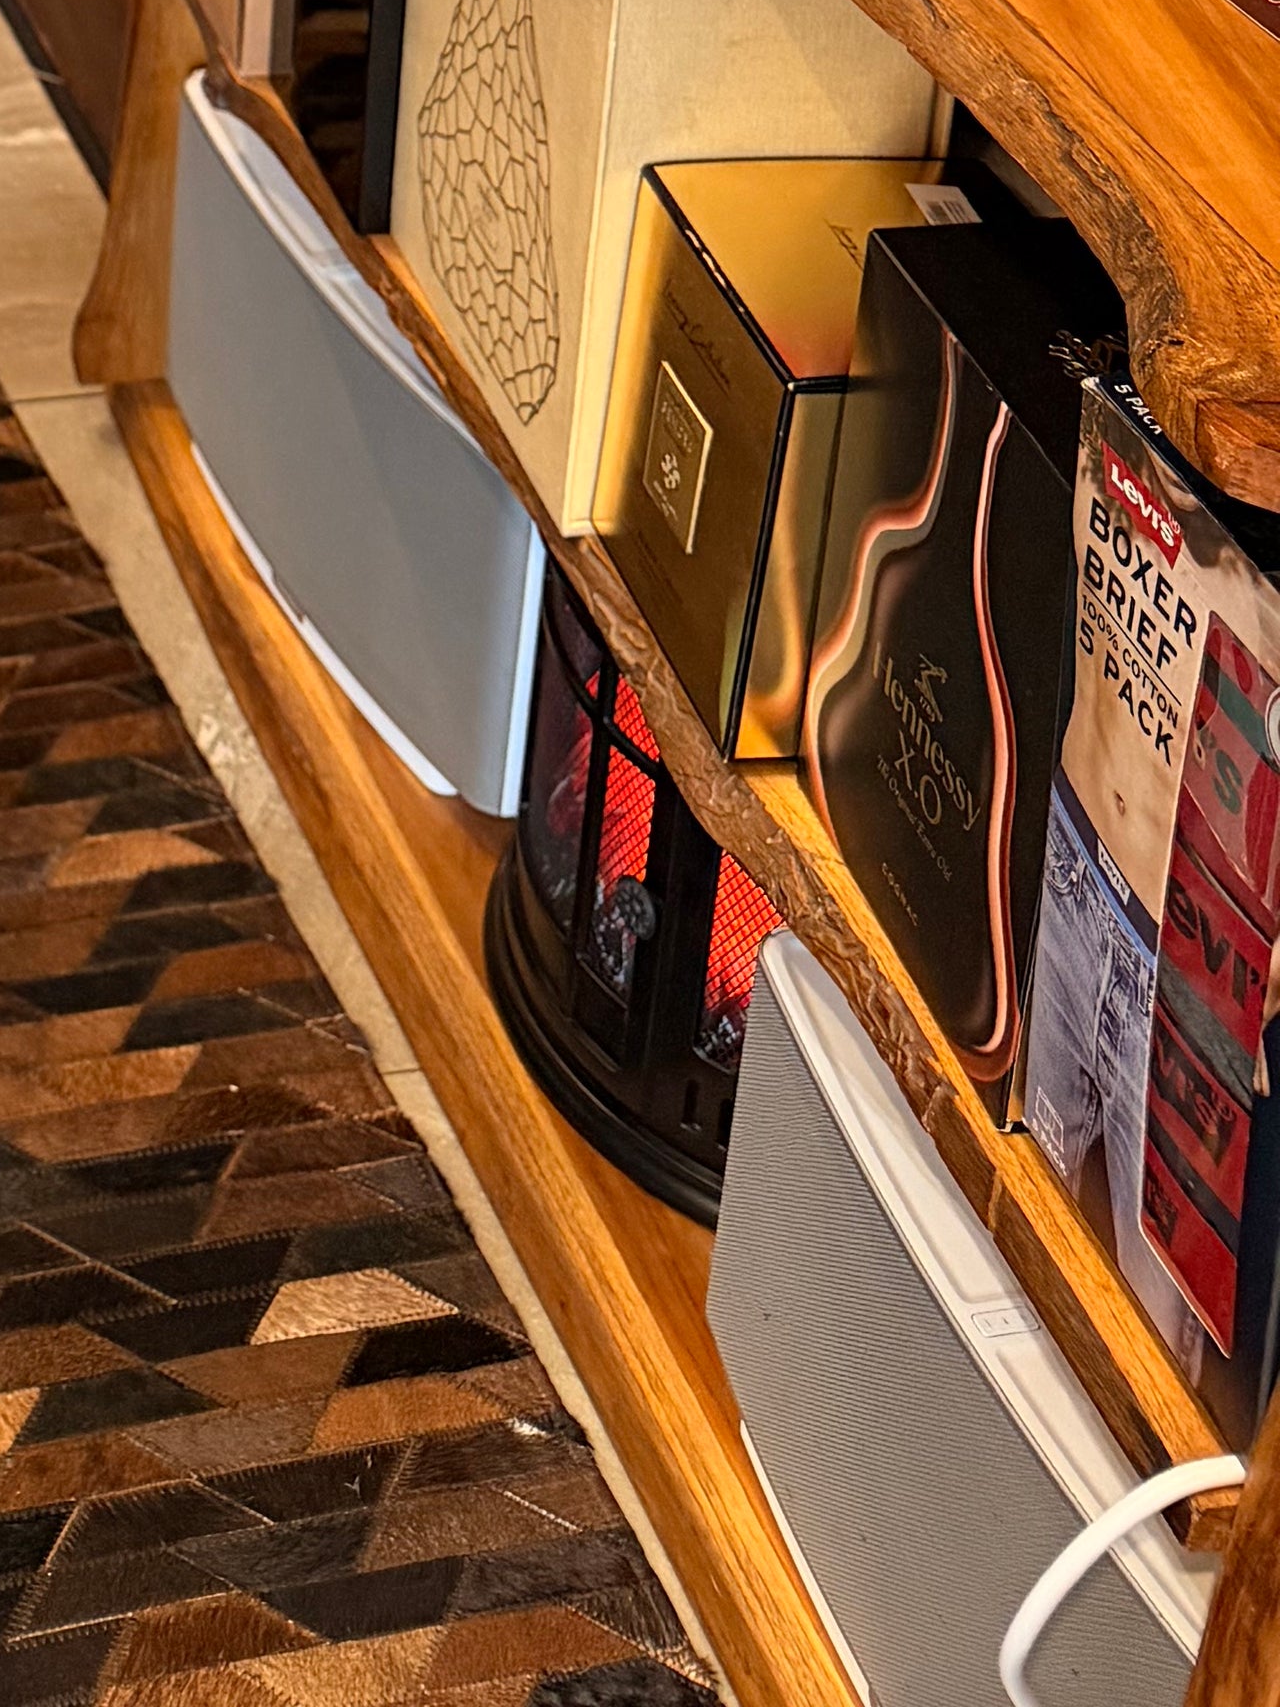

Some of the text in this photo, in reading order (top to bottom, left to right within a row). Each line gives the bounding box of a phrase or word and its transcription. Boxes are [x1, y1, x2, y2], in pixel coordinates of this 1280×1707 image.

[1114, 384, 1132, 394] 5
[1083, 544, 1178, 670] BRIEF
[1089, 496, 1197, 649] BOXER
[1079, 617, 1174, 767] 5 PACK
[1082, 594, 1178, 728] 100% COTTON
[873, 640, 981, 832] Hennessy
